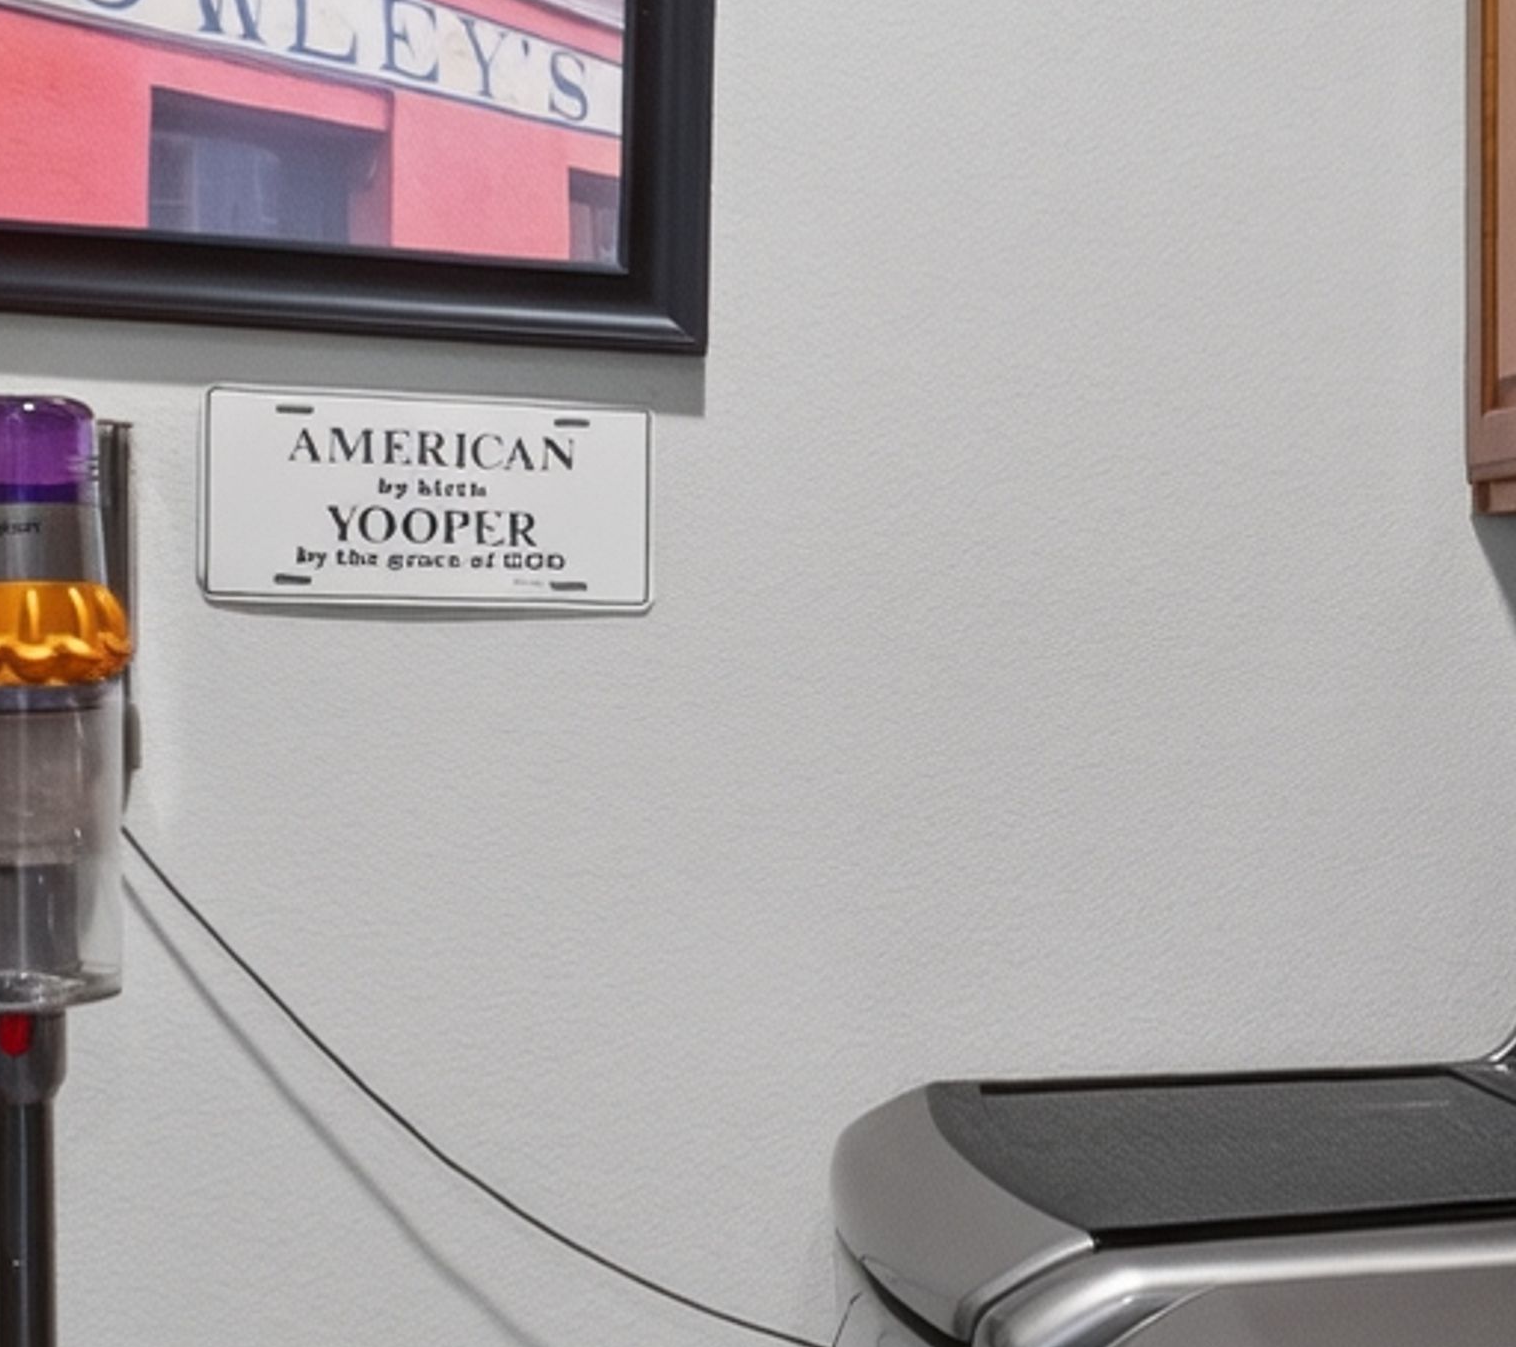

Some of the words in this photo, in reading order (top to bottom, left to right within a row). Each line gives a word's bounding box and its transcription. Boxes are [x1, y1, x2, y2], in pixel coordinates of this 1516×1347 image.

[288, 427, 575, 471] AMERICAN
[378, 478, 408, 499] by
[327, 505, 537, 548] YOOPER
[296, 547, 327, 569] by
[336, 549, 378, 566] the
[387, 554, 460, 569] grace
[470, 553, 494, 569] of
